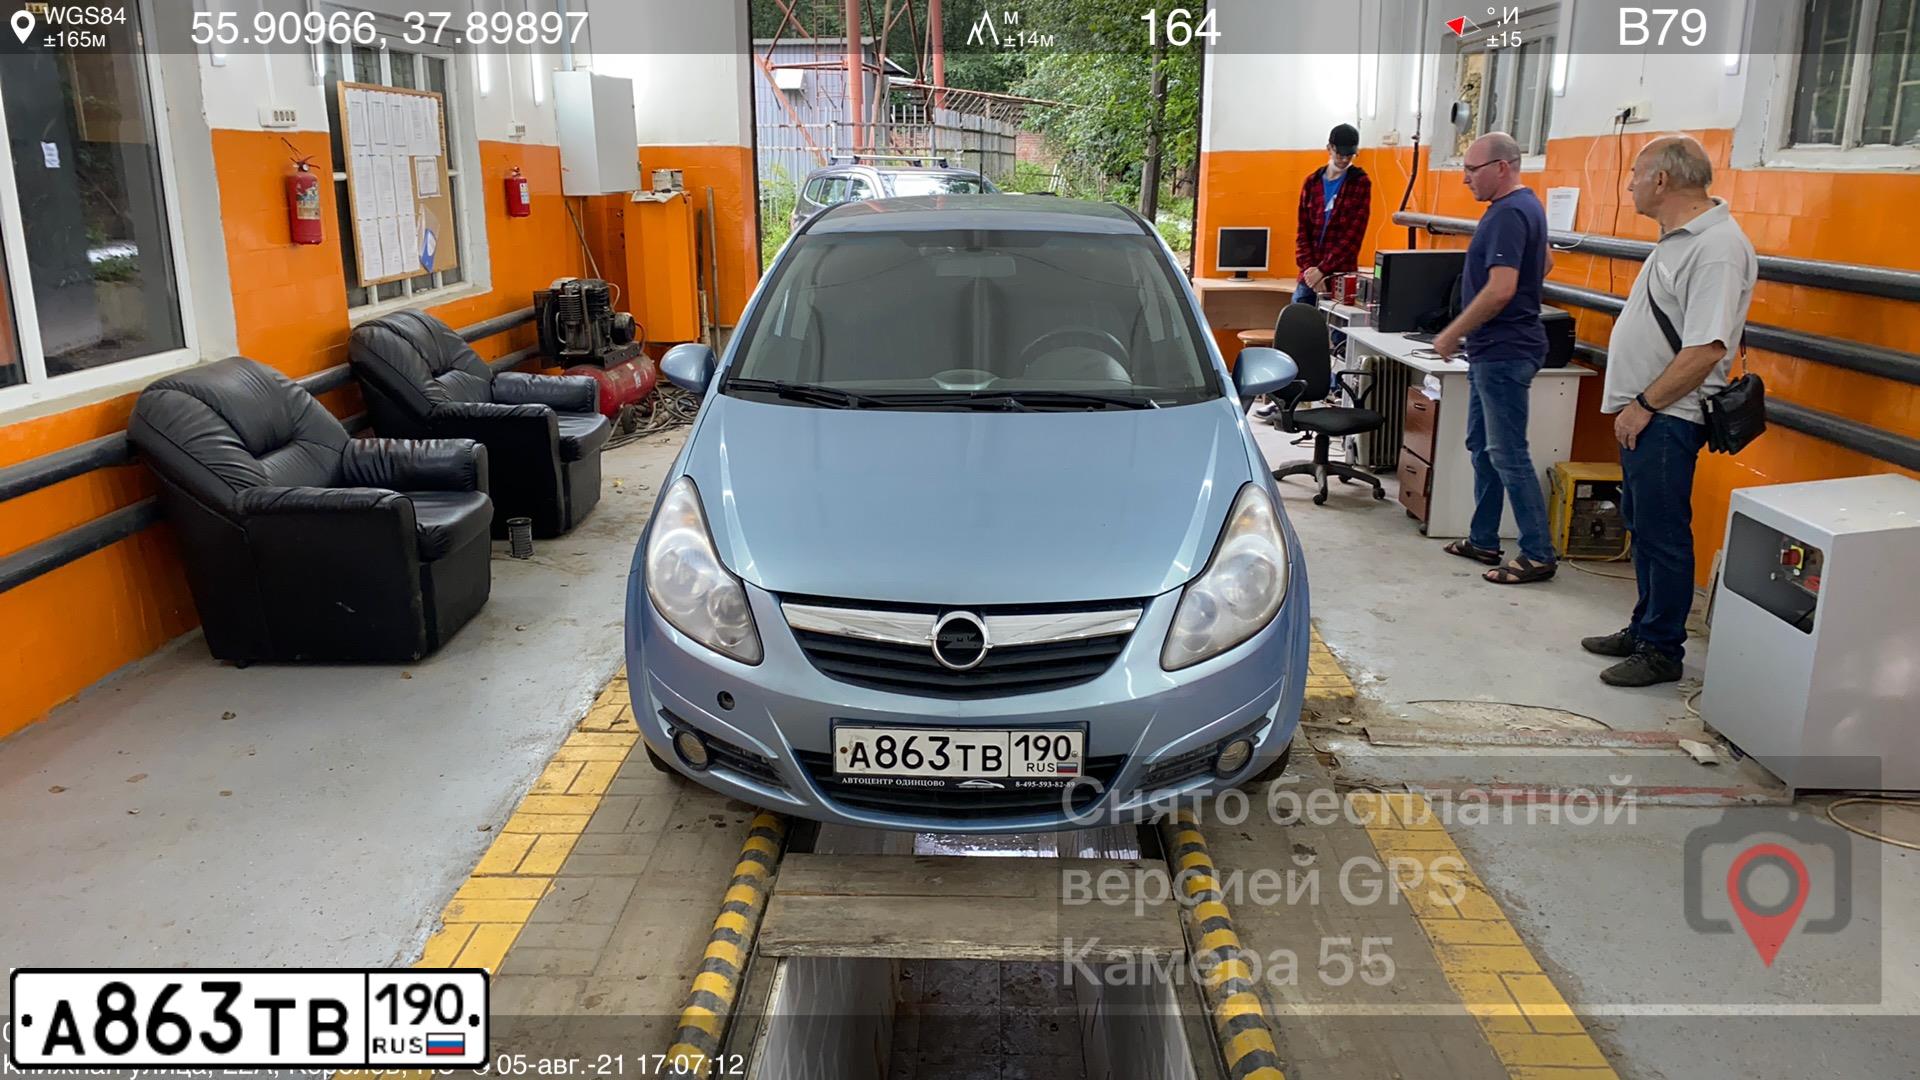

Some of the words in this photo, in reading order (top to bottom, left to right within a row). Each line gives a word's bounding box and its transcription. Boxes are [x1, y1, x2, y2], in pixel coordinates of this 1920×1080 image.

[849, 734, 1003, 772] А863ТВ
[1014, 734, 1072, 762] 190
[1026, 763, 1055, 773] RUS
[841, 777, 894, 786] АВТОЦЕНТР
[895, 778, 945, 787] ОДИНЦОВО
